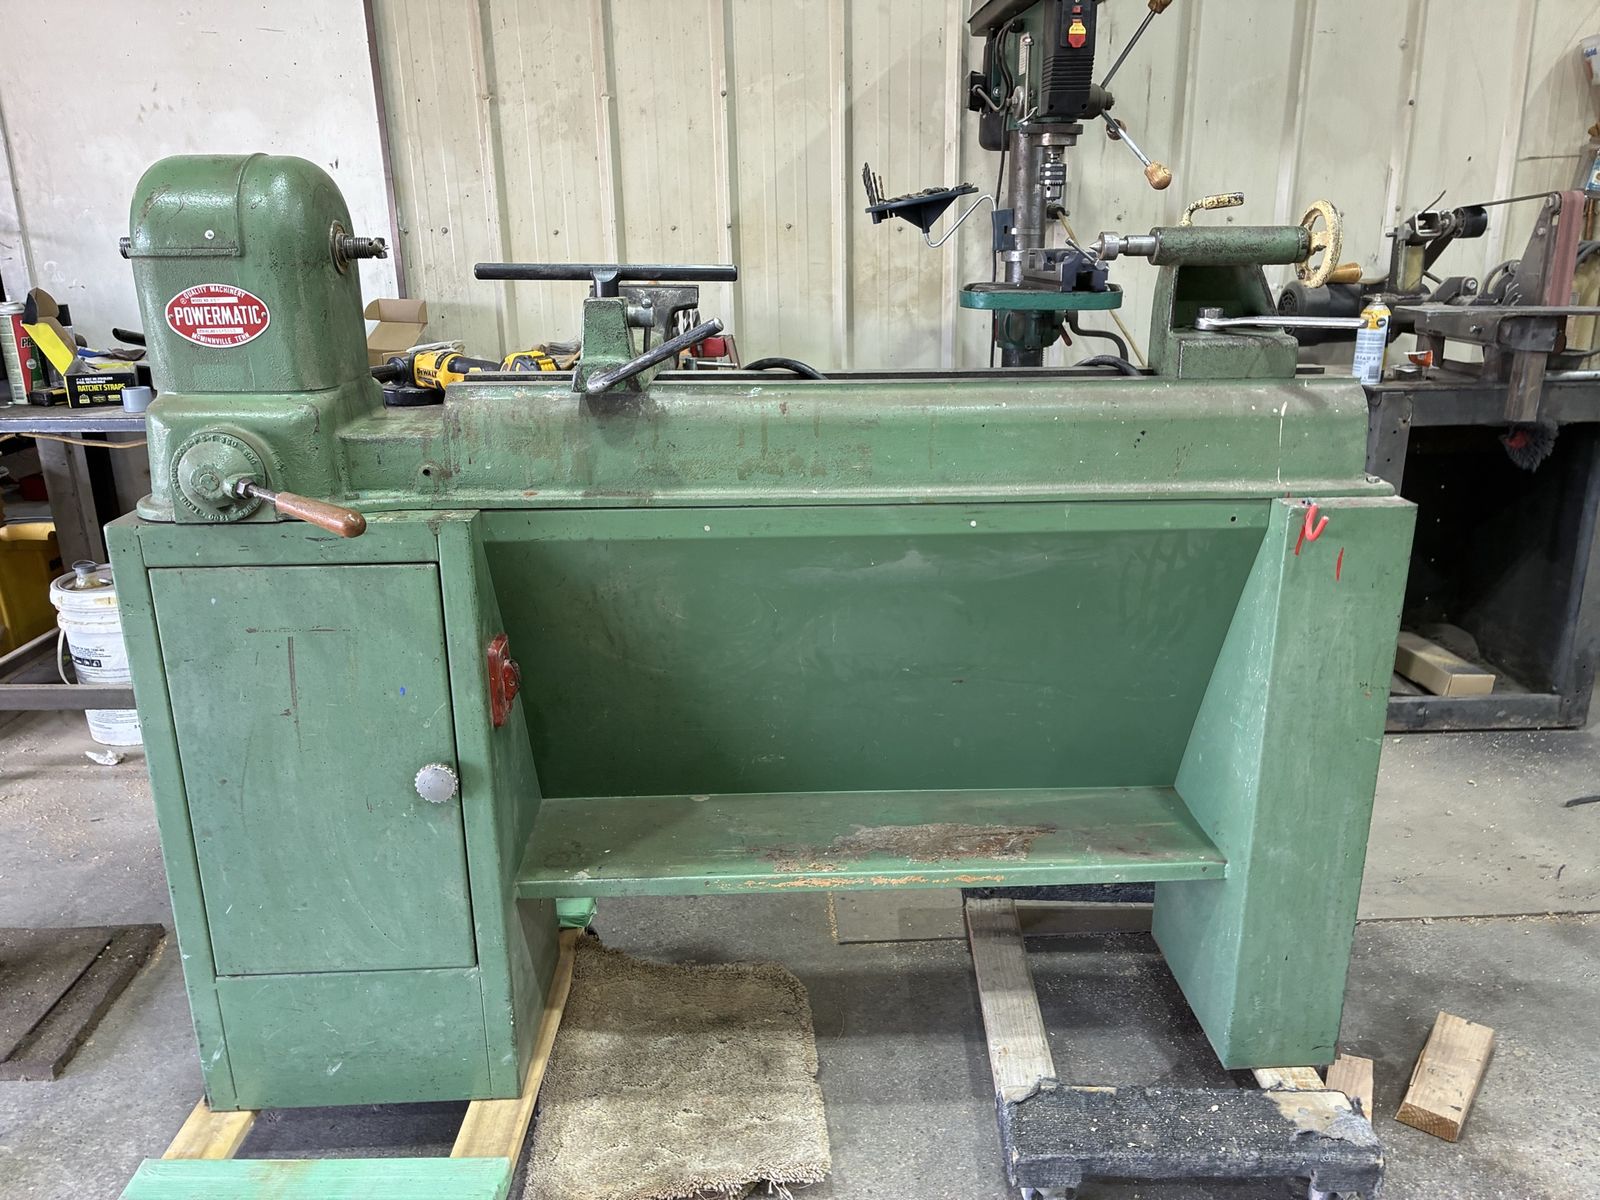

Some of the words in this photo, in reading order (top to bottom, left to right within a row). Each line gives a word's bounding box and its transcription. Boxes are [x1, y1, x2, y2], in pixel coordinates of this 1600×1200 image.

[183, 286, 207, 299] QUALITY
[209, 286, 245, 298] MACHINERY
[174, 306, 261, 325] POWERMATIC
[235, 332, 250, 342] TENN
[77, 384, 103, 392] RATCHET
[103, 383, 125, 391] STRAPS
